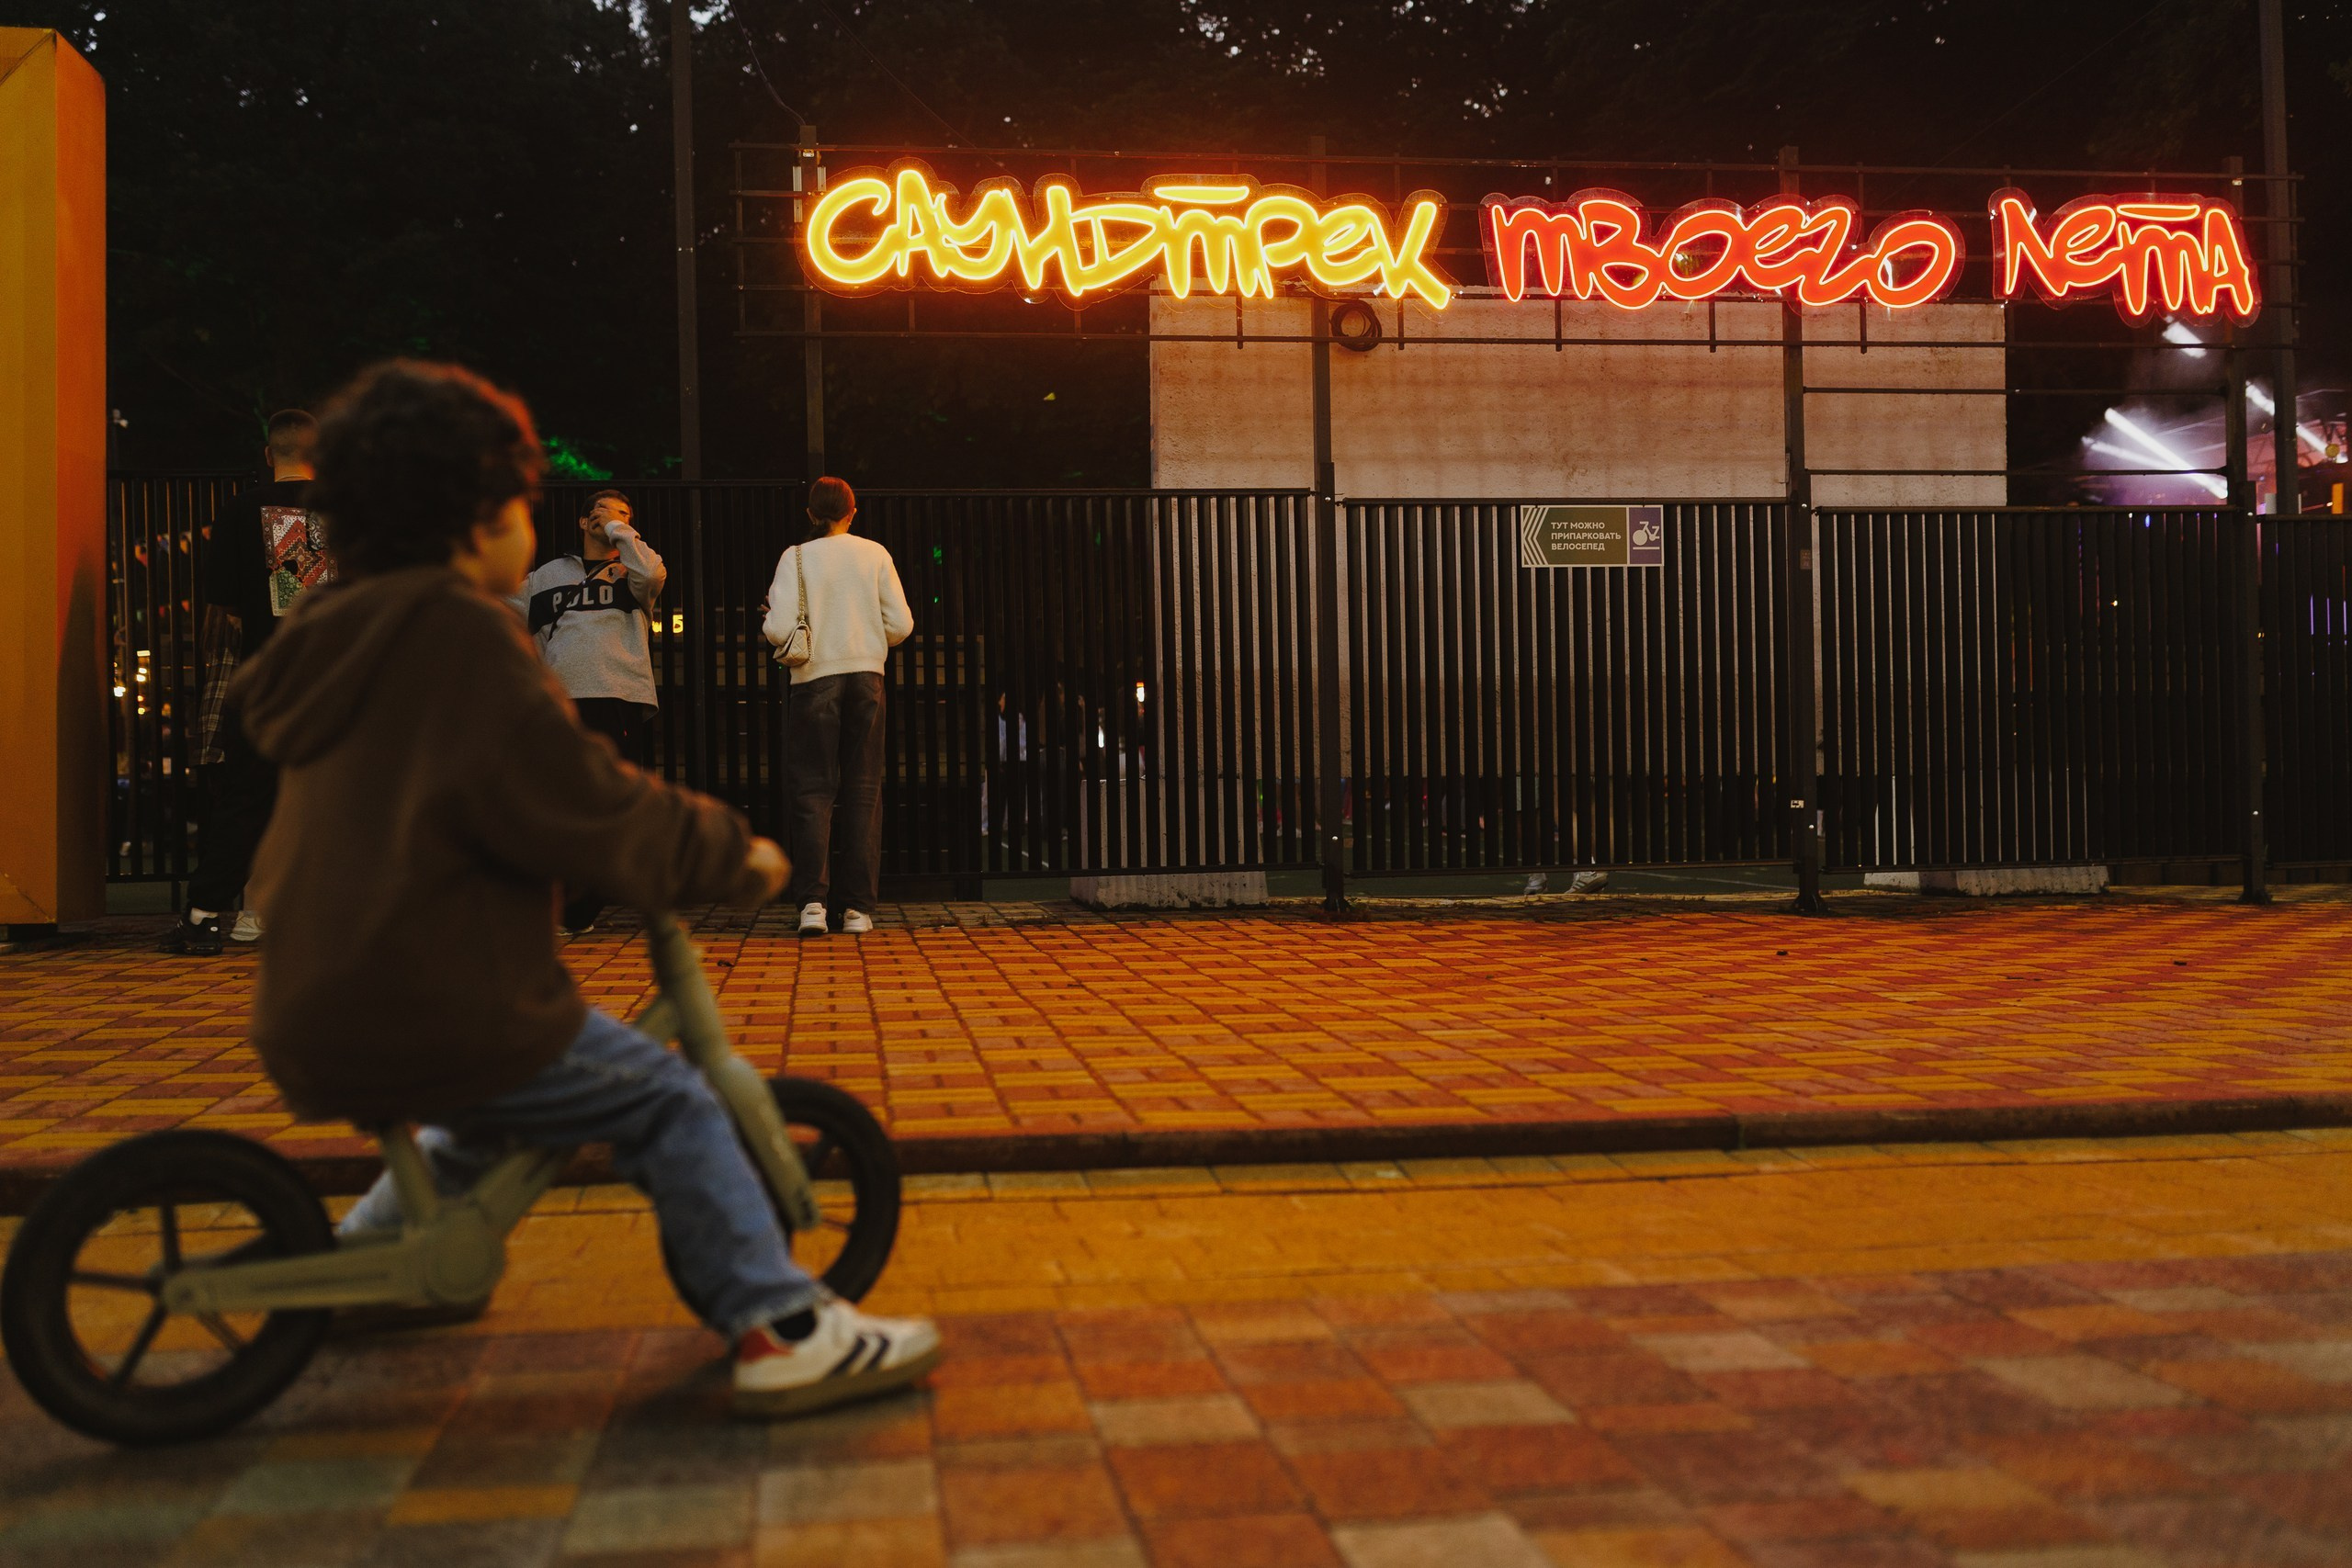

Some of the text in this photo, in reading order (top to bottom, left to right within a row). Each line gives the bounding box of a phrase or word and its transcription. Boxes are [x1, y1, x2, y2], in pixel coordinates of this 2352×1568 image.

[1551, 522, 1605, 530] ТУТ МОЖНО
[1551, 532, 1622, 540] ПРИПАРКОВАТЬ
[1551, 543, 1605, 551] ВЕЛОСЕПЕД
